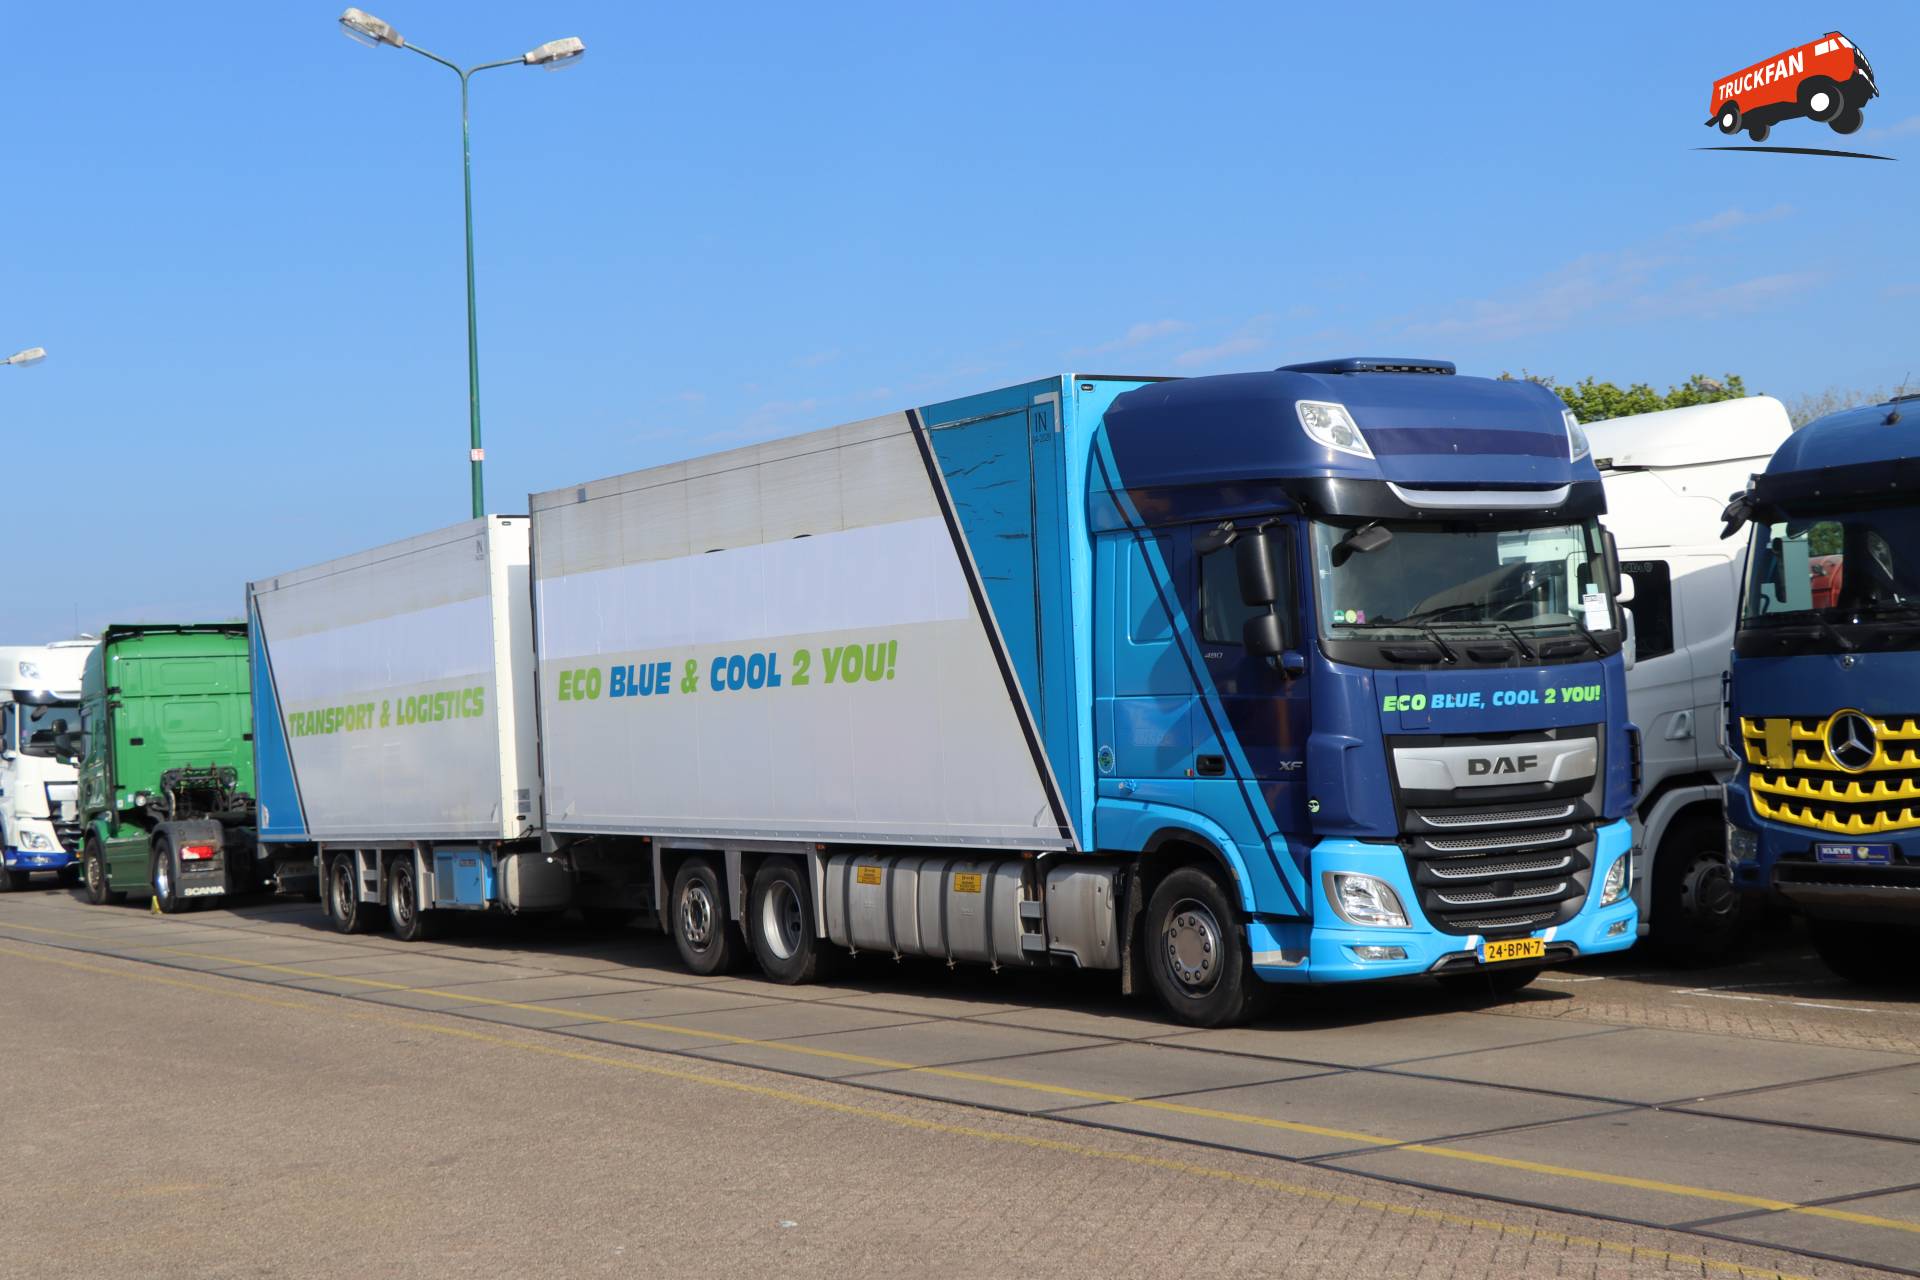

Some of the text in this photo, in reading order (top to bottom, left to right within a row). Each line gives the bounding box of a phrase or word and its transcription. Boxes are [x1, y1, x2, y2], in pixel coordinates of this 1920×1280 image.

[558, 639, 898, 701] ECO BLUE & COOL 2 YOU!
[1383, 685, 1601, 712] ECO BLUE, COOL 2 YOU!
[288, 687, 484, 737] TRANSPORT & LOGISTICS
[1280, 761, 1303, 770] XF
[1468, 755, 1538, 776] DAF
[184, 886, 225, 896] SCANIA
[1488, 941, 1540, 958] 24-BPN-7
